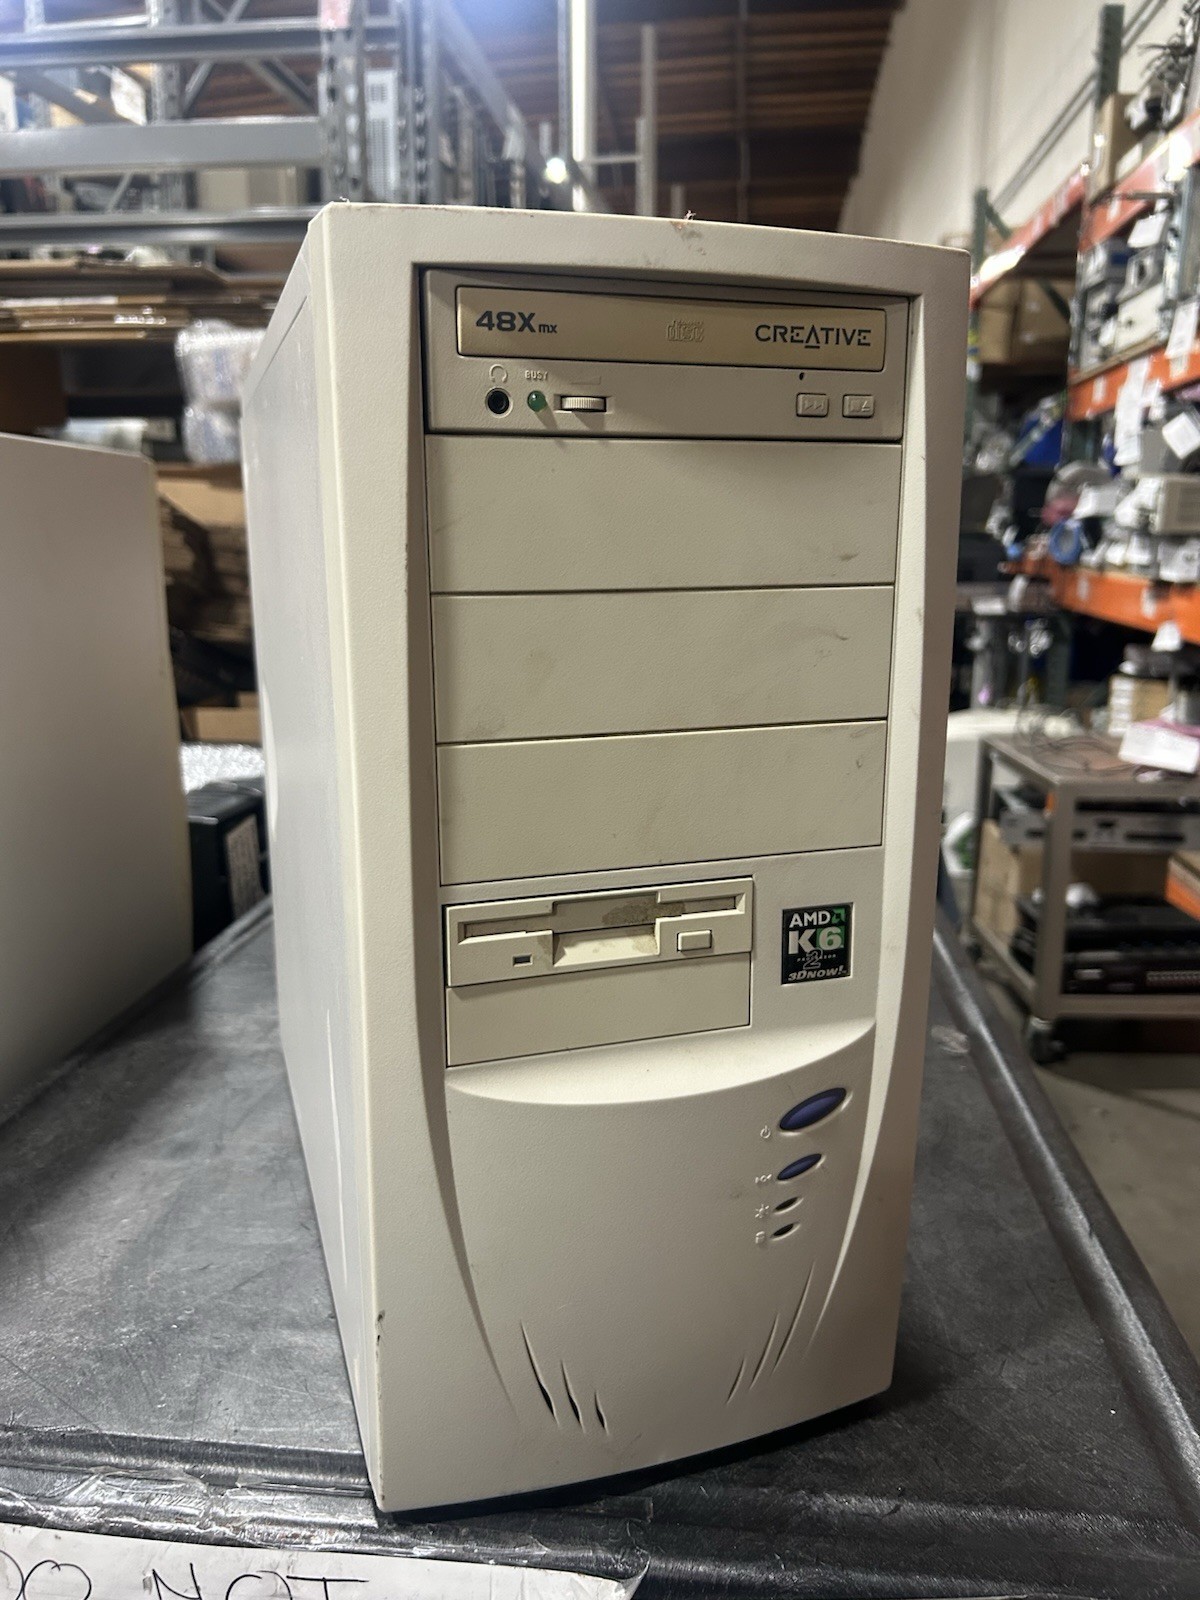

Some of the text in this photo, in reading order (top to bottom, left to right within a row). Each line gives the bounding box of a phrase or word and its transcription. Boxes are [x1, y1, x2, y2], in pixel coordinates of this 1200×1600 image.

[476, 310, 558, 334] 48X mx
[755, 324, 872, 349] CREATIVE
[524, 369, 549, 381] BUSY
[789, 910, 831, 928] AMD
[788, 926, 842, 955] K6
